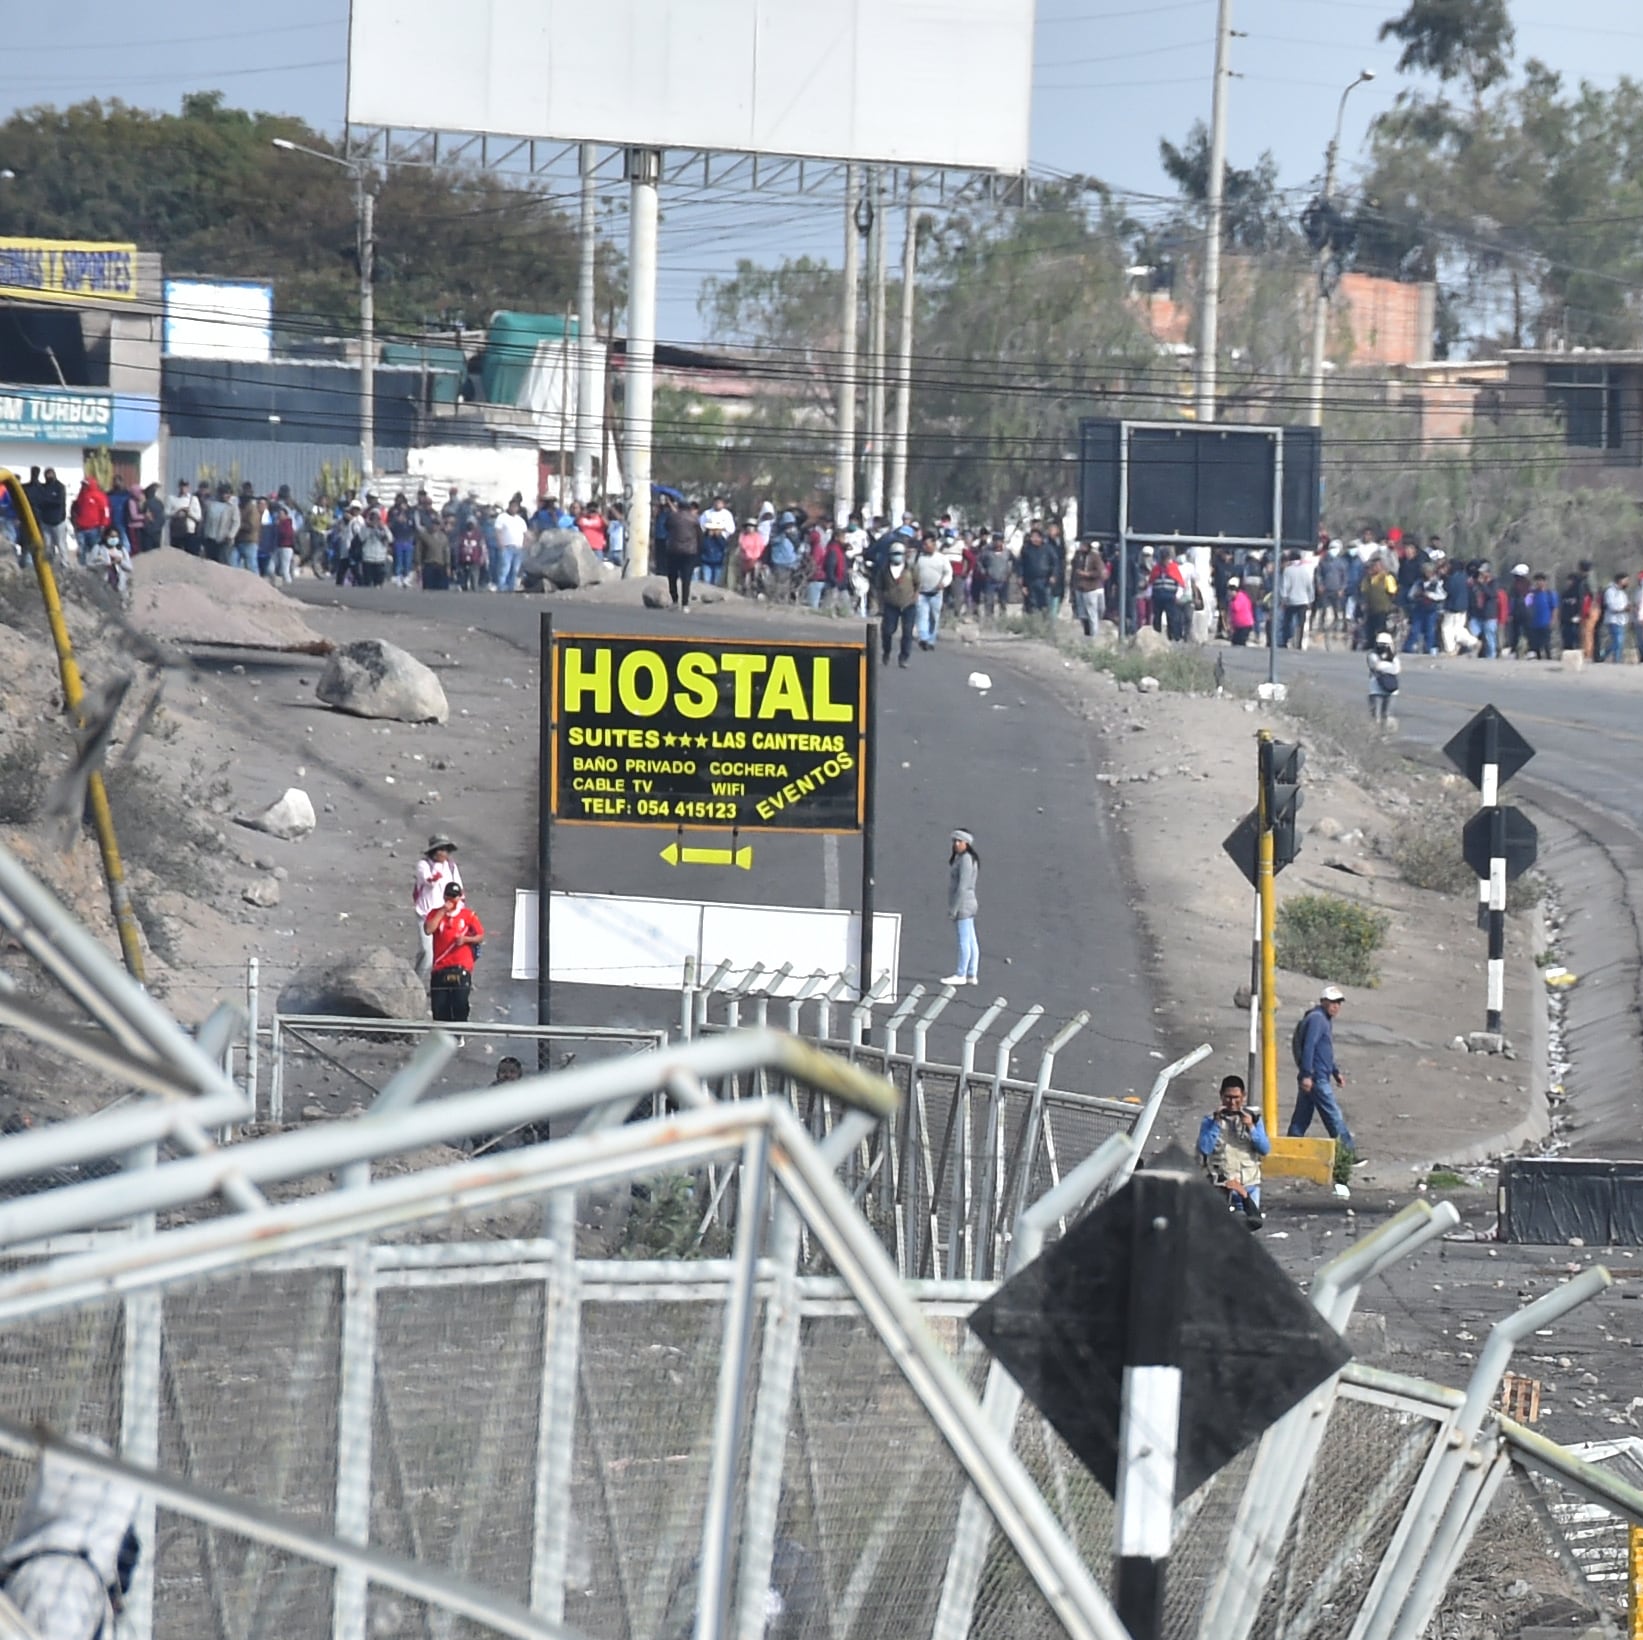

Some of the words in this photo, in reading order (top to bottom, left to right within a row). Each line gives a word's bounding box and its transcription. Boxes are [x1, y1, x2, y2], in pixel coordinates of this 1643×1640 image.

[29, 396, 111, 424] TURBOS
[564, 647, 853, 722] HOSTAL
[568, 727, 660, 748] SUITES
[712, 731, 746, 749] LAS
[752, 732, 844, 752] CANTERAS
[573, 756, 618, 772] BAÑO
[625, 758, 696, 774] PRIVADO
[709, 762, 788, 778] COCHERA
[573, 778, 625, 792] CABLE
[633, 779, 653, 793] TV
[711, 782, 745, 797] WIFI
[756, 751, 854, 820] EVENTOS
[582, 797, 631, 815] TELF:
[637, 798, 669, 816] 054
[674, 801, 737, 819] 415123
